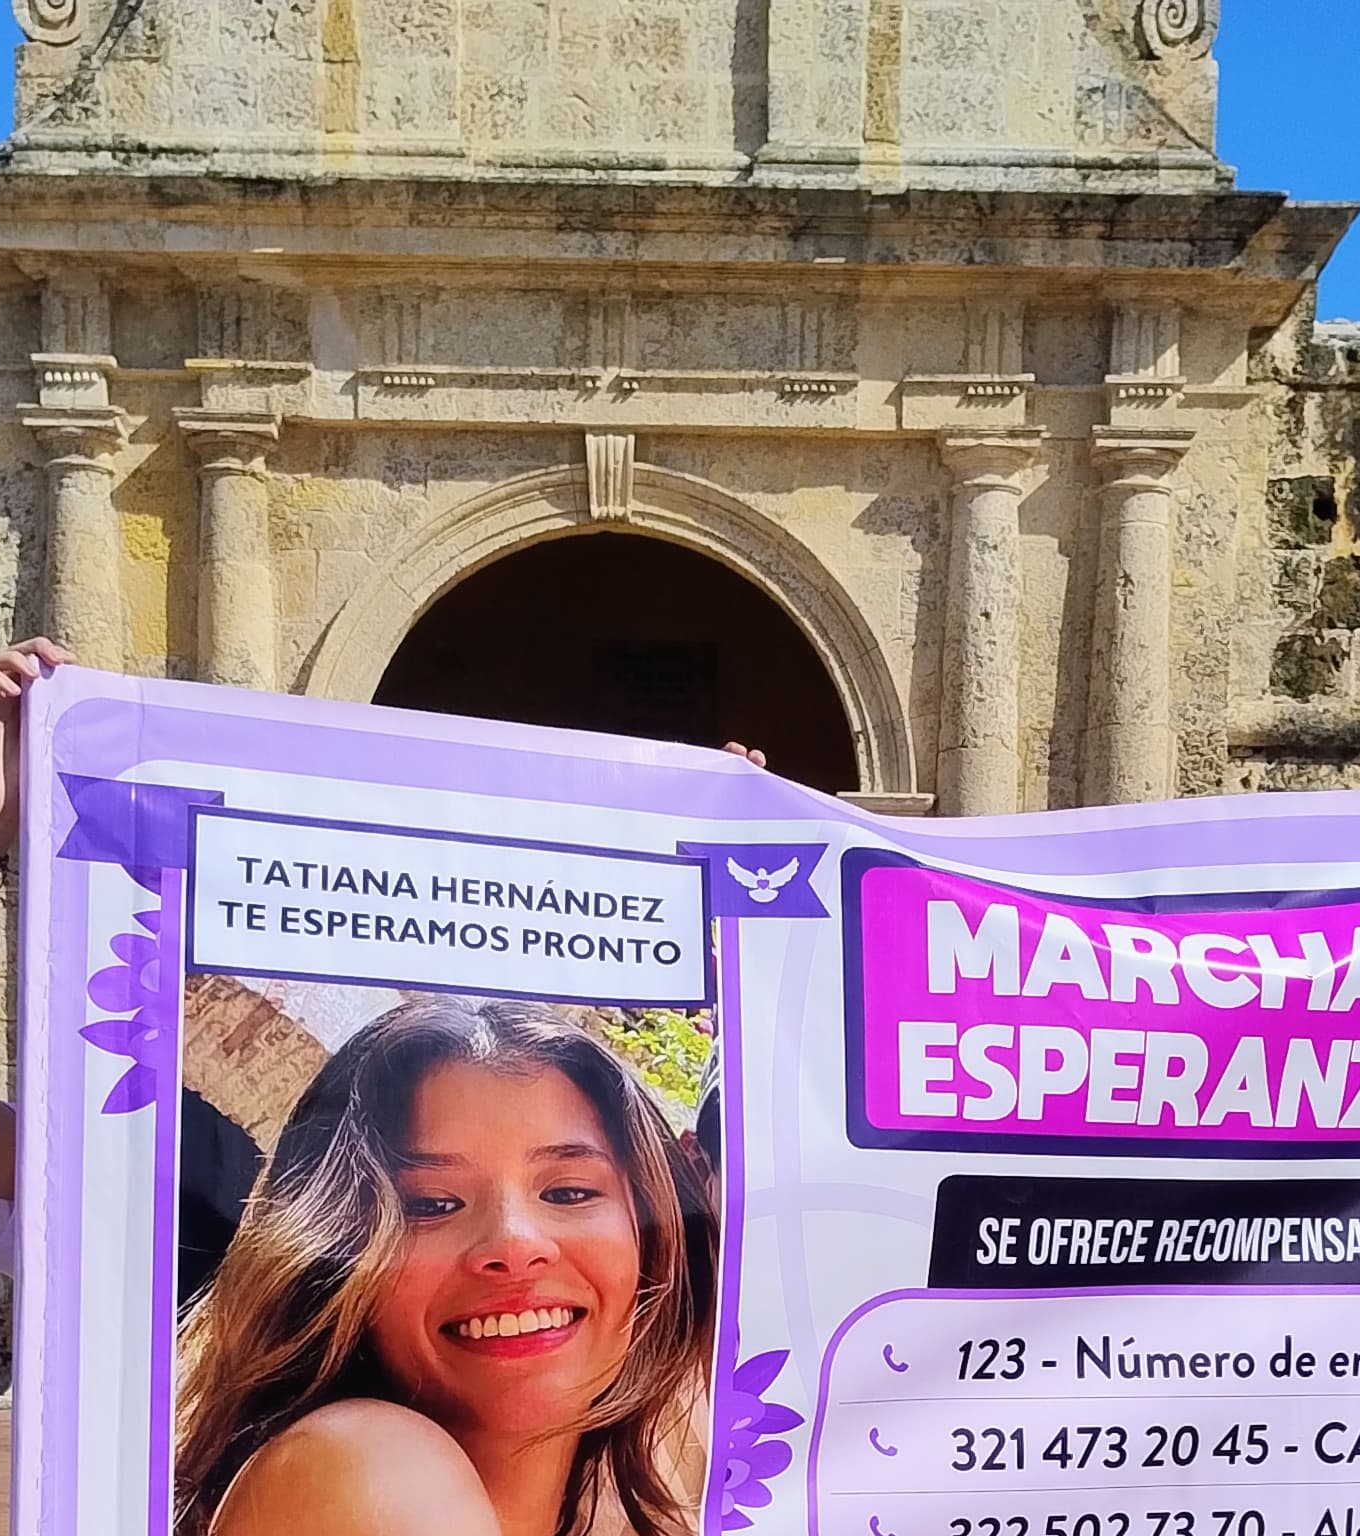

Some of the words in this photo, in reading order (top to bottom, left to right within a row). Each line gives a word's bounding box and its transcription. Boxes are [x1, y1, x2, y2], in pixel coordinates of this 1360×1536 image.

[237, 857, 418, 899] TATIANA
[432, 876, 664, 922] HERNÁNDEZ
[218, 901, 265, 930] TE
[281, 907, 509, 951] ESPERAMOS
[523, 929, 681, 965] PRONTO
[977, 1218, 1020, 1264] SE
[1028, 1218, 1151, 1265] OFRECE
[959, 1338, 1025, 1379] 123
[1077, 1336, 1254, 1378] Número
[1270, 1335, 1315, 1377] de
[952, 1428, 1024, 1471] 321
[1043, 1427, 1127, 1469] 473
[1142, 1426, 1199, 1467] 20
[1213, 1424, 1268, 1464] 45
